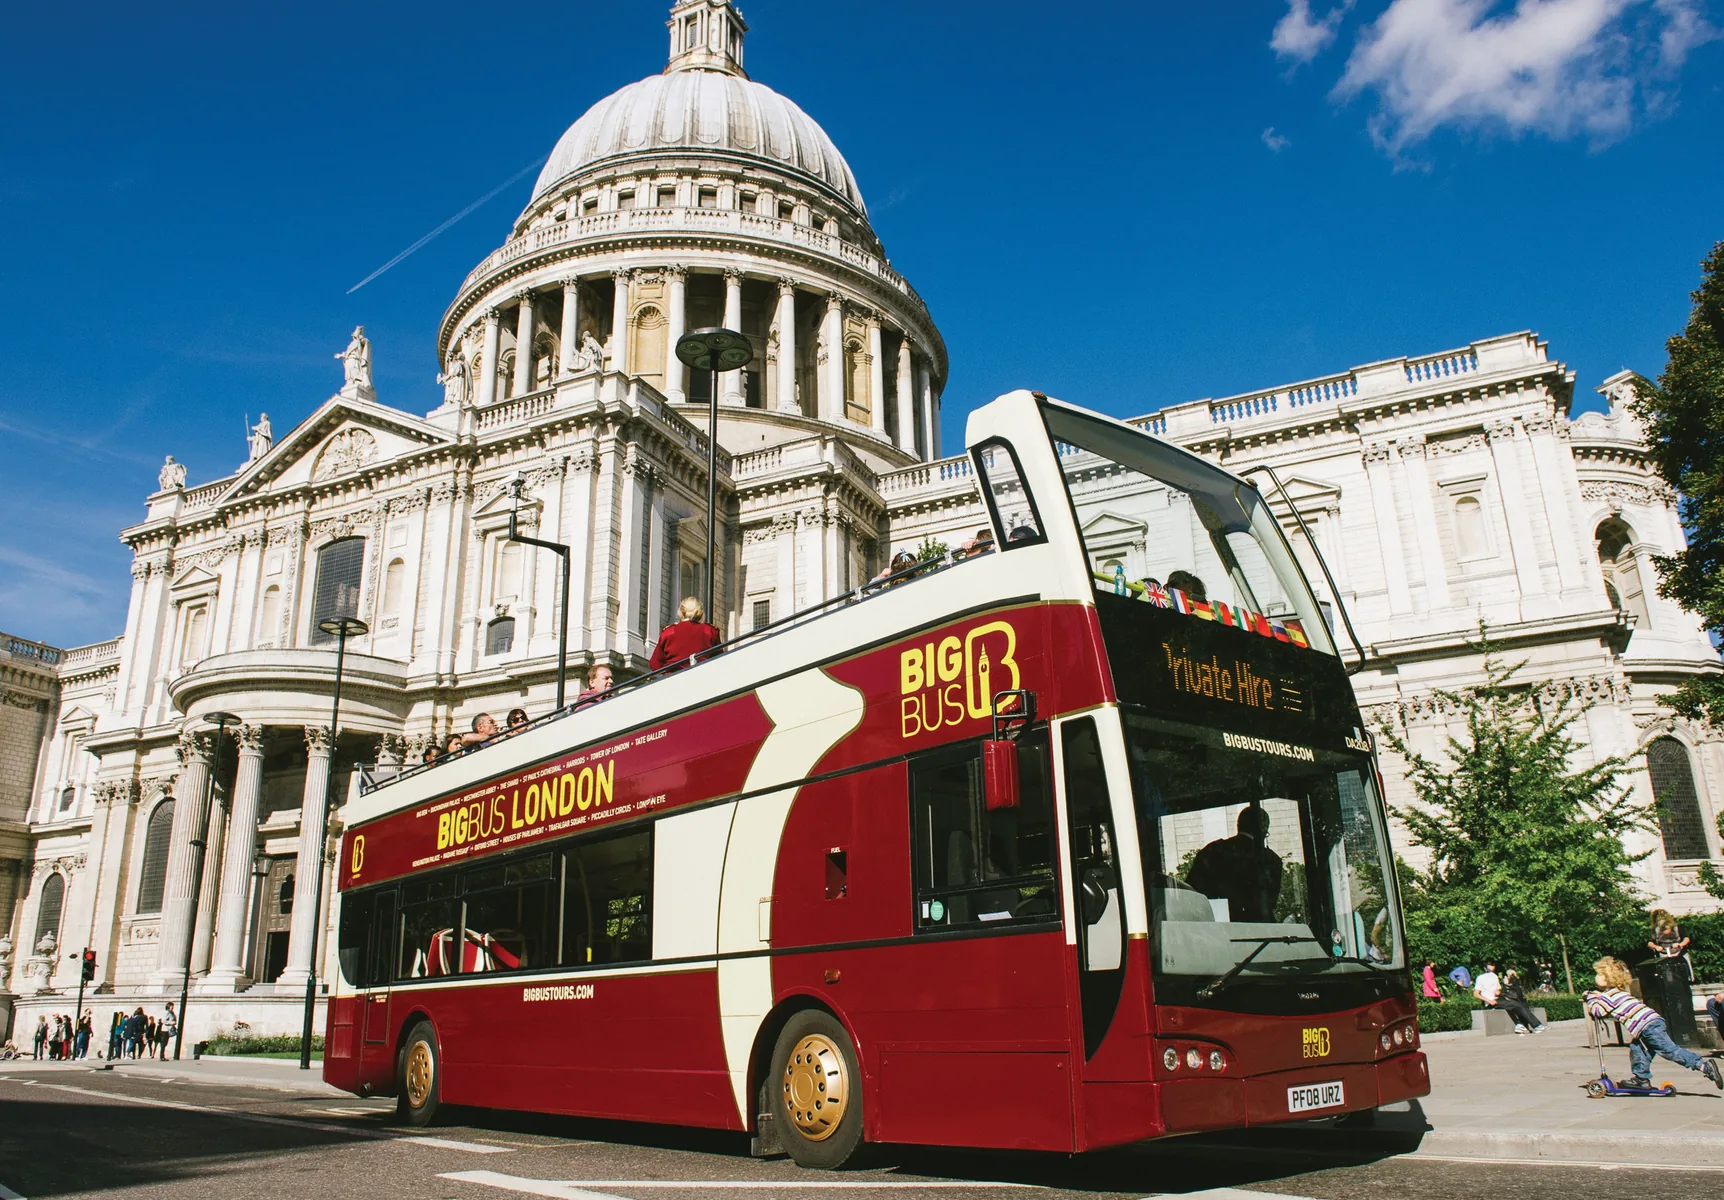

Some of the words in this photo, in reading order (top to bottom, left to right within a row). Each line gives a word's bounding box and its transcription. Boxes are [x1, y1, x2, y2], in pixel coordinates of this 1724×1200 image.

[901, 635, 963, 695] BIG
[1235, 660, 1275, 710] Hire
[901, 683, 965, 738] BUS
[566, 756, 585, 768] HARRODS
[590, 750, 604, 761] TOWER
[611, 741, 629, 754] LONDON
[635, 736, 646, 746] TATE
[646, 729, 668, 742] GALLERY
[1223, 732, 1315, 762] BIGBUSTOURS.COM
[511, 759, 615, 828] LONDON
[591, 808, 614, 820] PICCADILLY
[614, 804, 631, 815] CIRCUS
[657, 794, 666, 804] EYE
[523, 984, 594, 1002] BIGBUSTOURS.COM
[1302, 1028, 1318, 1044] BIG
[1303, 1044, 1318, 1059] BUS
[1292, 1088, 1319, 1109] PF08
[1321, 1085, 1341, 1105] URZ
